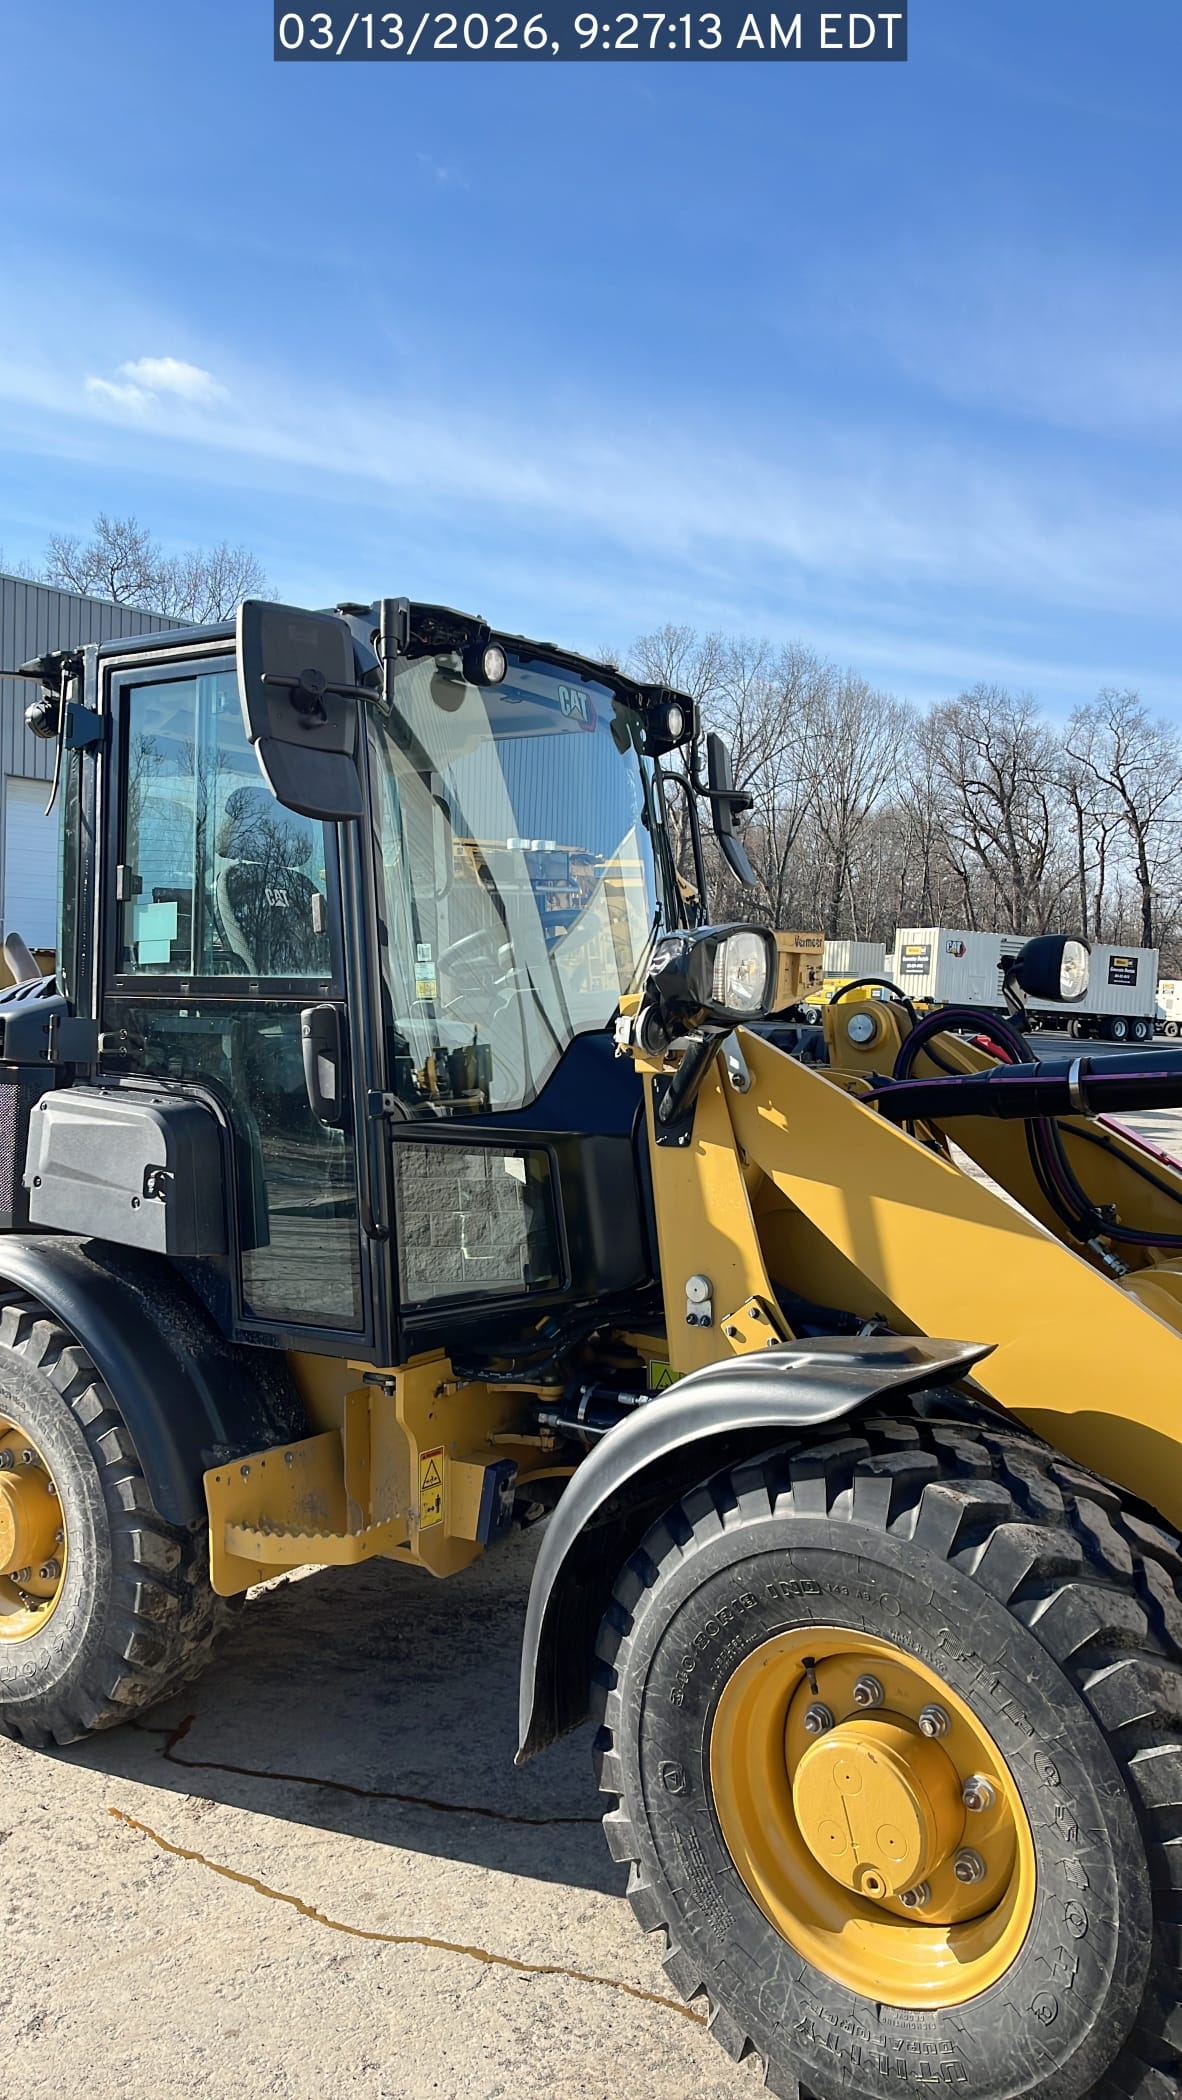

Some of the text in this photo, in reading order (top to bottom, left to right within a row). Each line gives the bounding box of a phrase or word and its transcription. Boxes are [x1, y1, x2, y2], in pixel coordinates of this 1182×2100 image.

[558, 685, 589, 722] CAT
[265, 888, 289, 907] CAT
[946, 940, 964, 955] CAT
[766, 1580, 823, 1599] IND
[794, 2015, 968, 2083] UTILITY
